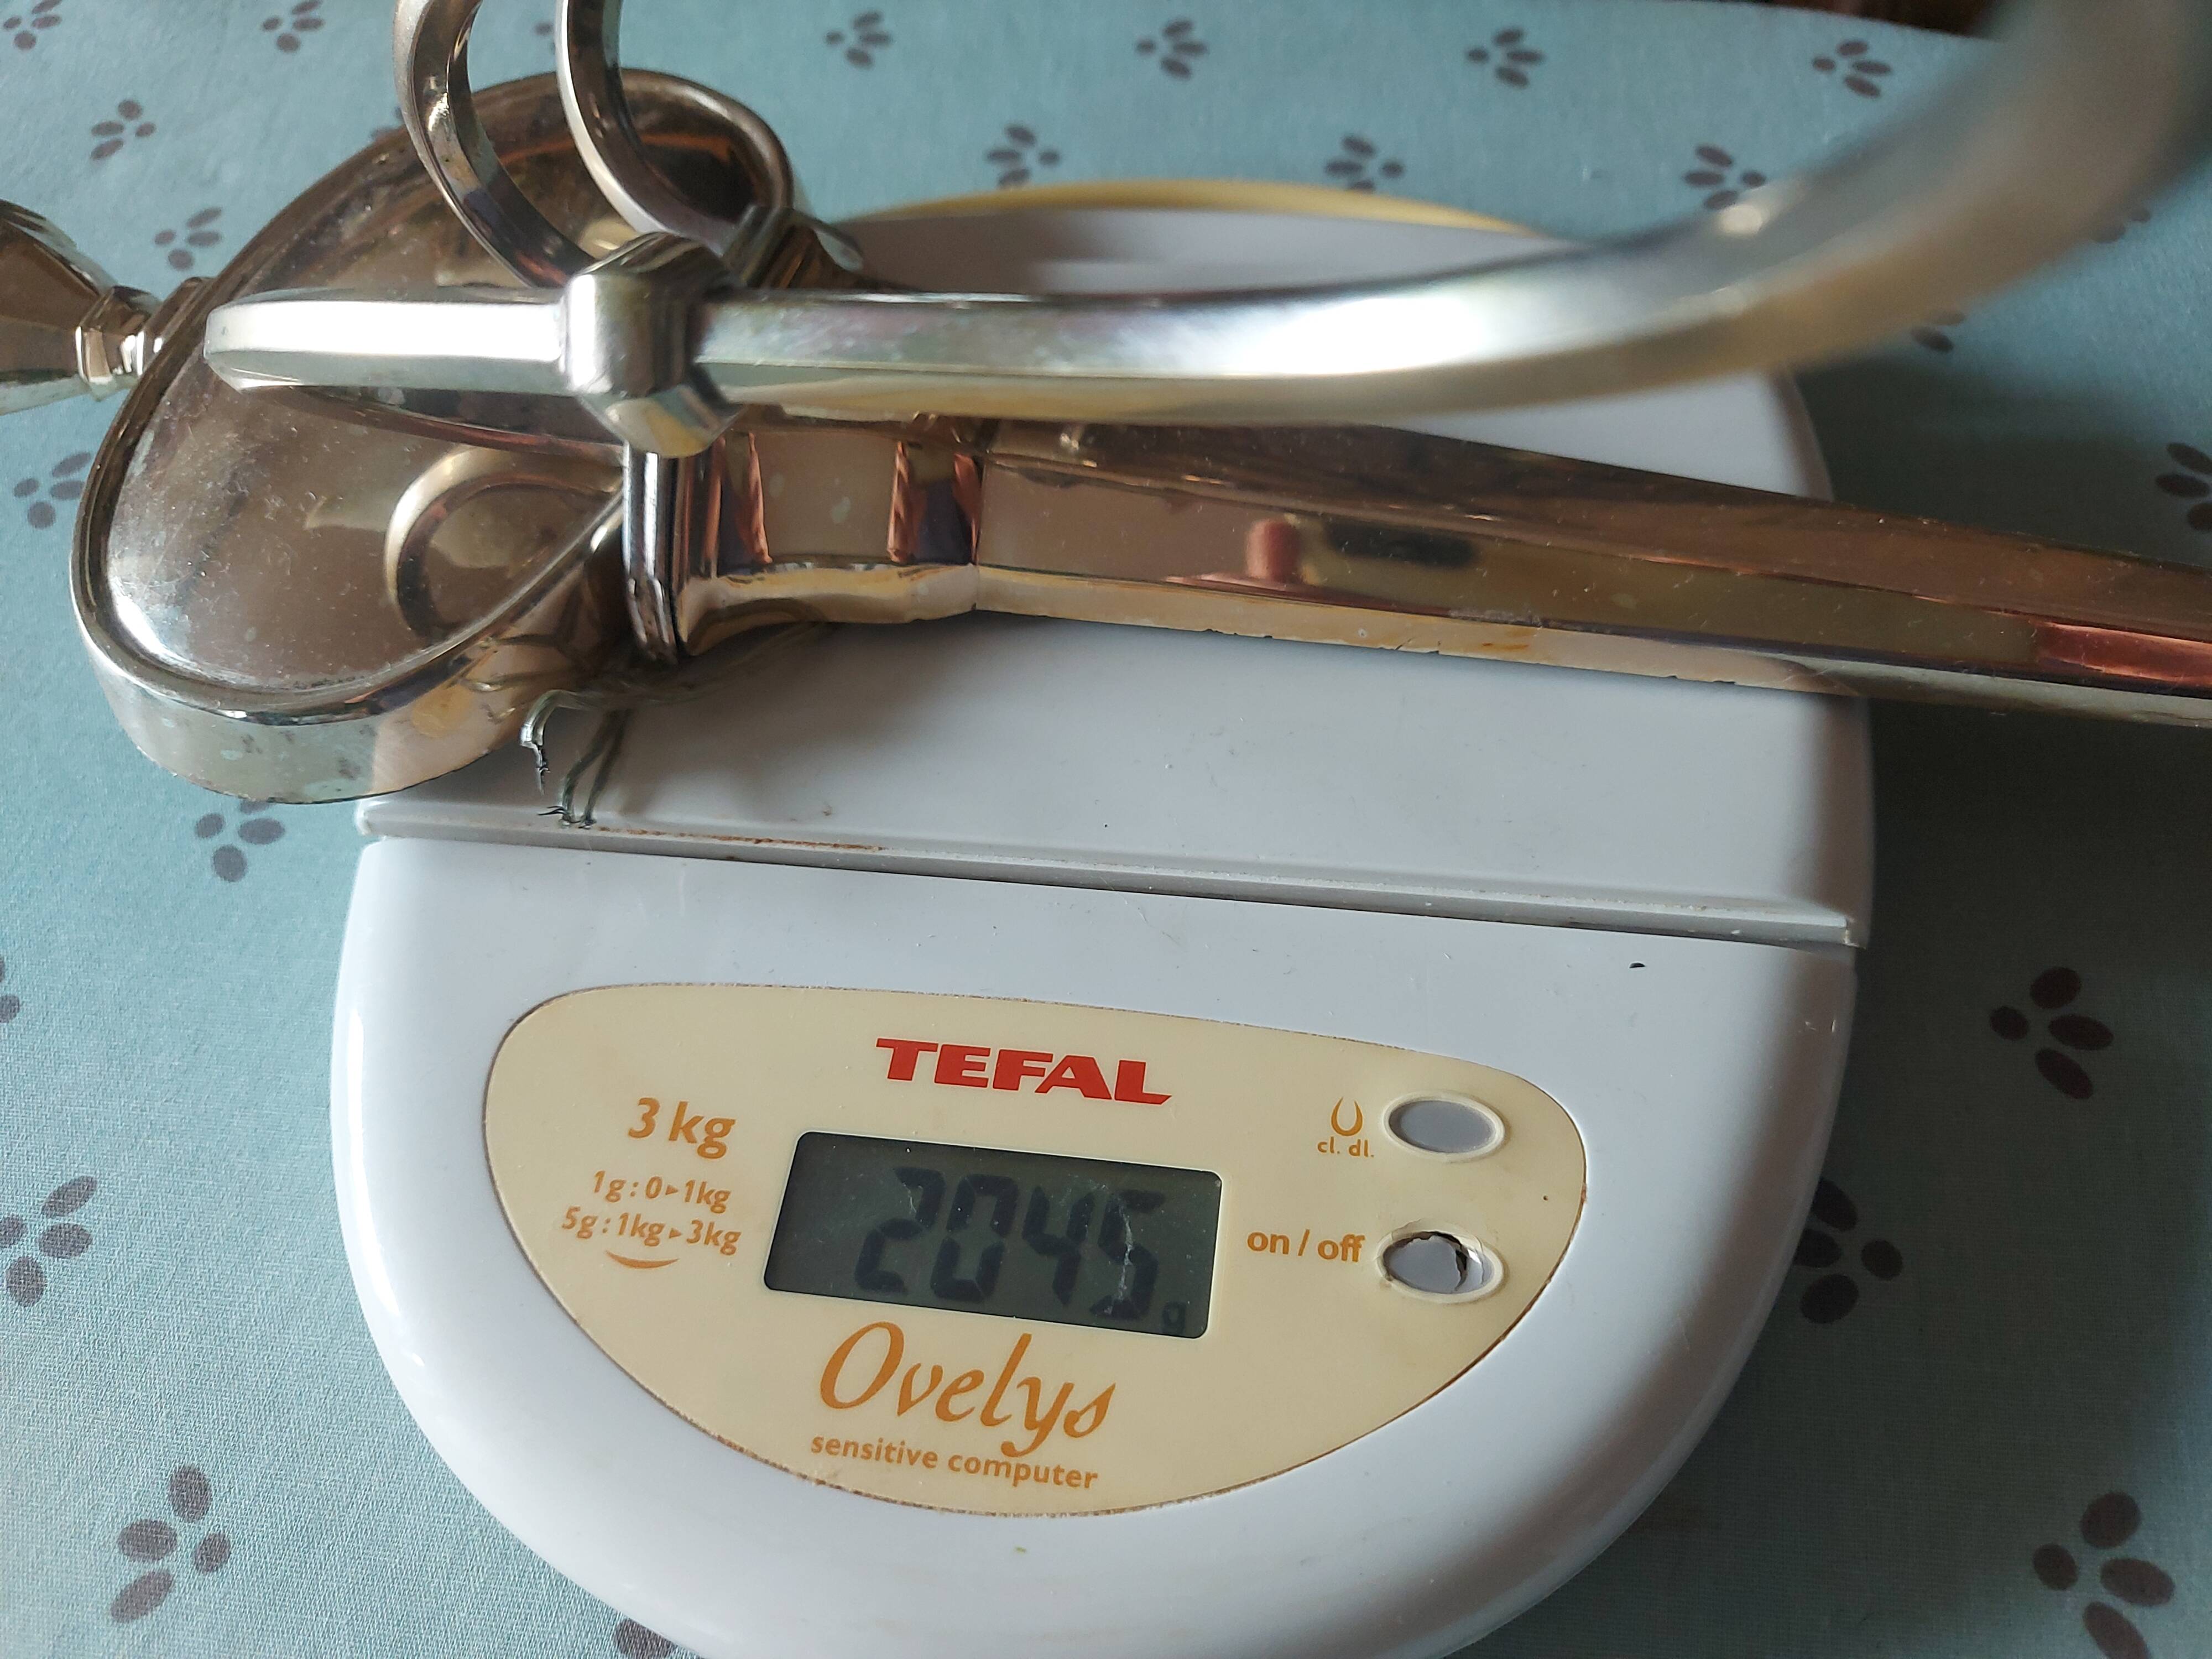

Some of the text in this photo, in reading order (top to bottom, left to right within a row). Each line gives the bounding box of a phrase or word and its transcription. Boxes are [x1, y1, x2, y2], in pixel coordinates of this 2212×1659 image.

[876, 1037, 1172, 1105] TEFAL
[628, 1097, 736, 1159] 3 kg
[1317, 1137, 1374, 1157] cl. dl.
[854, 1166, 1166, 1320] 2045
[820, 1321, 1117, 1458] Ovelys
[811, 1436, 1099, 1489] sensitive computer
